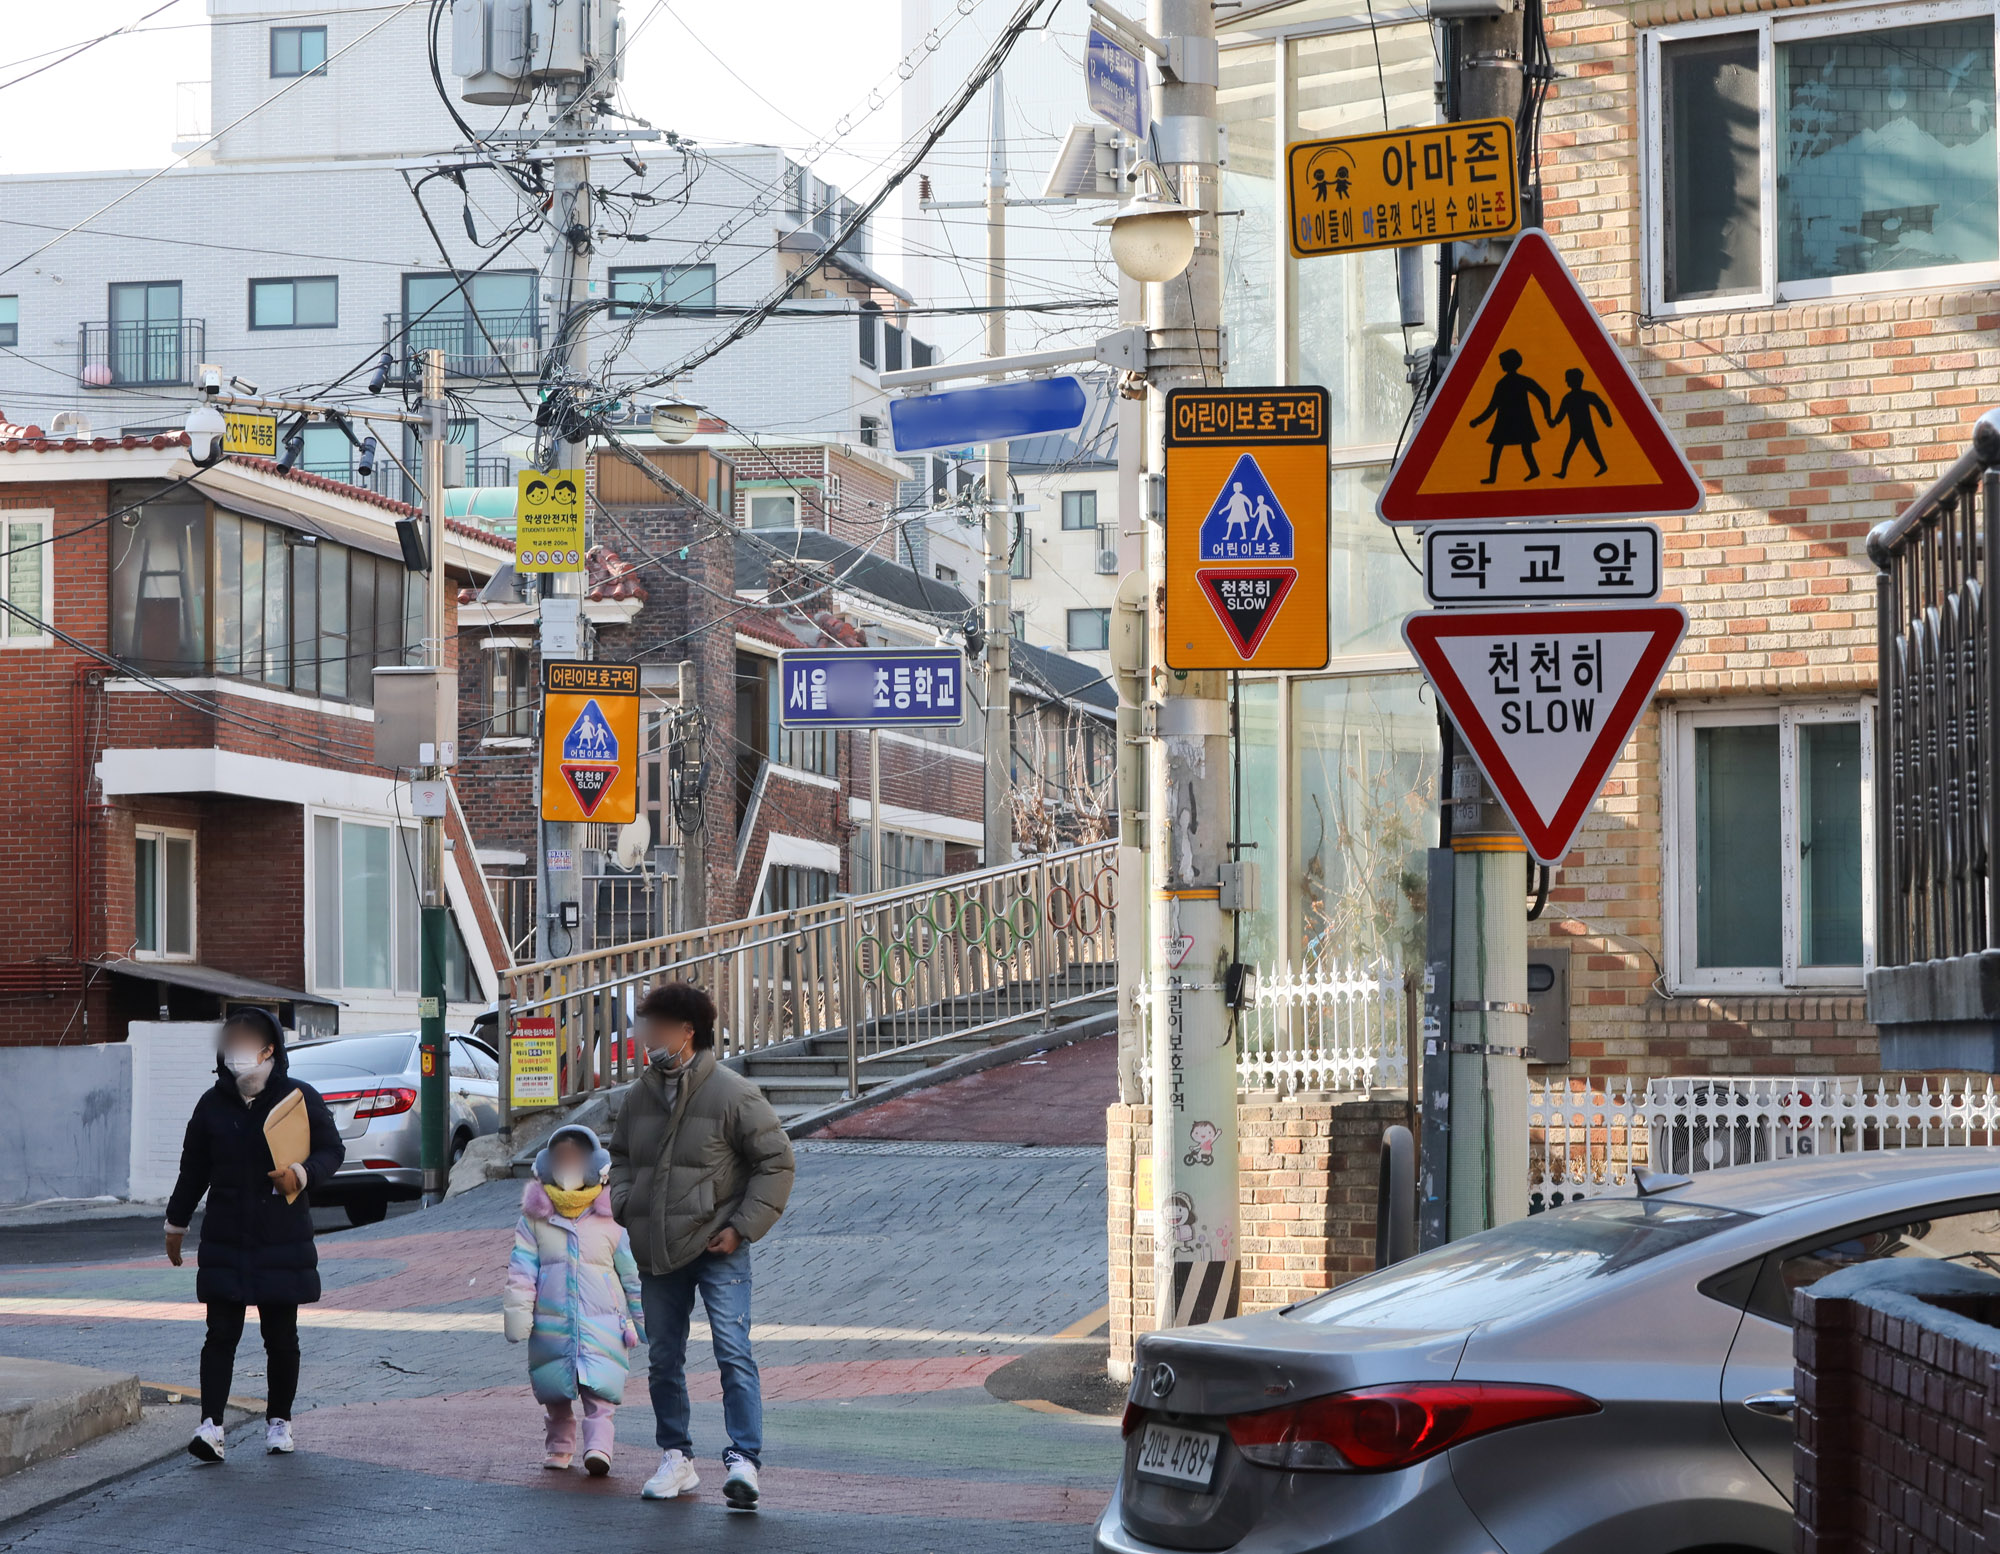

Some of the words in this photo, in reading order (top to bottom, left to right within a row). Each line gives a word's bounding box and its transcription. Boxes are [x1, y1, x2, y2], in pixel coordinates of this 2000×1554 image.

[1383, 131, 1499, 191] 아마존
[1301, 206, 1353, 245] 아이들이
[1362, 202, 1402, 239] 마음껏
[1411, 198, 1437, 235] 다닐
[1446, 196, 1458, 231] 수
[1179, 400, 1316, 434] 어린이보호구역
[226, 422, 250, 444] CCTV
[251, 424, 273, 447] 작동중
[524, 513, 578, 525] 학생안전지역
[1212, 541, 1281, 556] 어린이보호
[1220, 580, 1271, 598] 천천히
[1226, 597, 1267, 611] SLOW
[1488, 638, 1603, 695] 천천히
[552, 667, 634, 689] 어린이보호구역
[789, 668, 828, 711] 서울
[872, 666, 955, 710] 초등학교
[1500, 697, 1595, 735] SLOW
[570, 748, 611, 759] 어린이보호
[574, 770, 604, 782] 천천히
[577, 781, 602, 790] SLOW
[1785, 1135, 1812, 1155] LG
[1170, 1434, 1210, 1477] 4789
